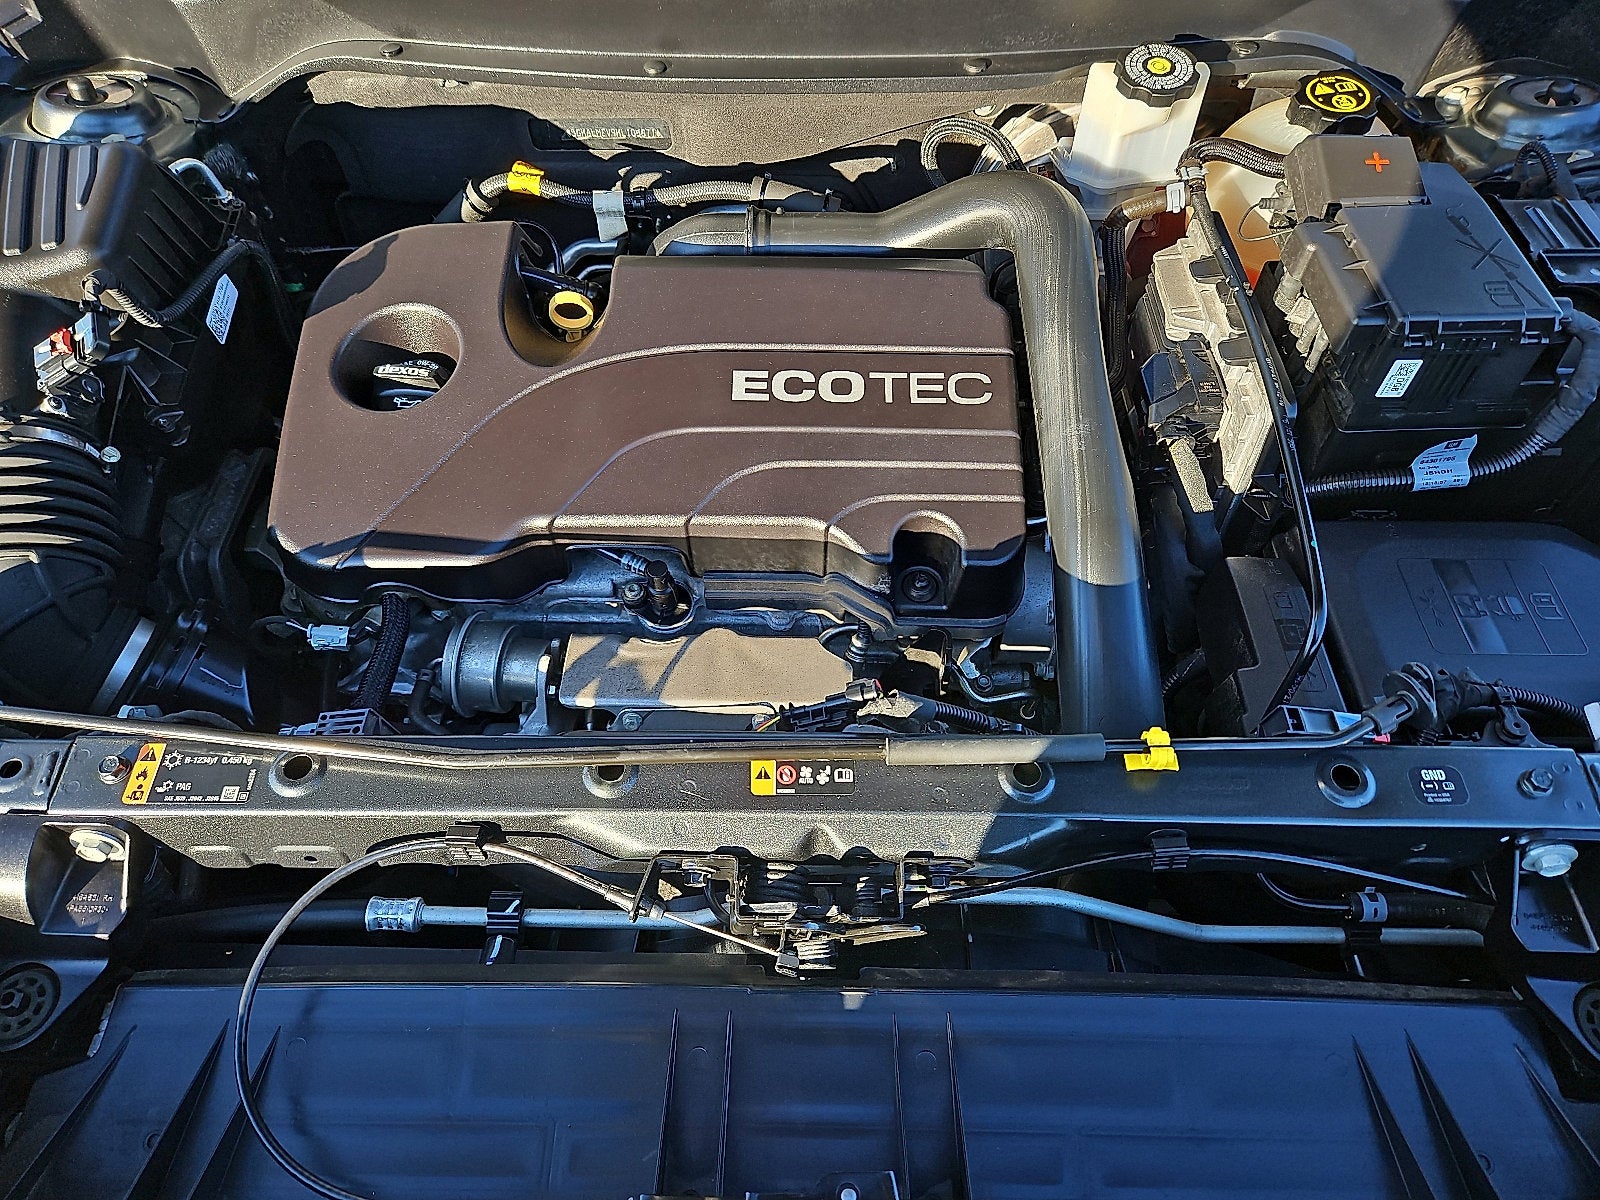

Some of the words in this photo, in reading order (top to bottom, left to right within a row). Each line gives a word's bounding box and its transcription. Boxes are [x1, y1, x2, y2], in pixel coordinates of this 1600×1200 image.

[377, 363, 430, 377] dexos
[731, 369, 993, 405] ECOTEC
[184, 756, 219, 765] R-1234yf
[221, 756, 242, 765] 0.450
[243, 756, 253, 766] kg
[1420, 769, 1446, 781] GND
[175, 782, 192, 791] PAG
